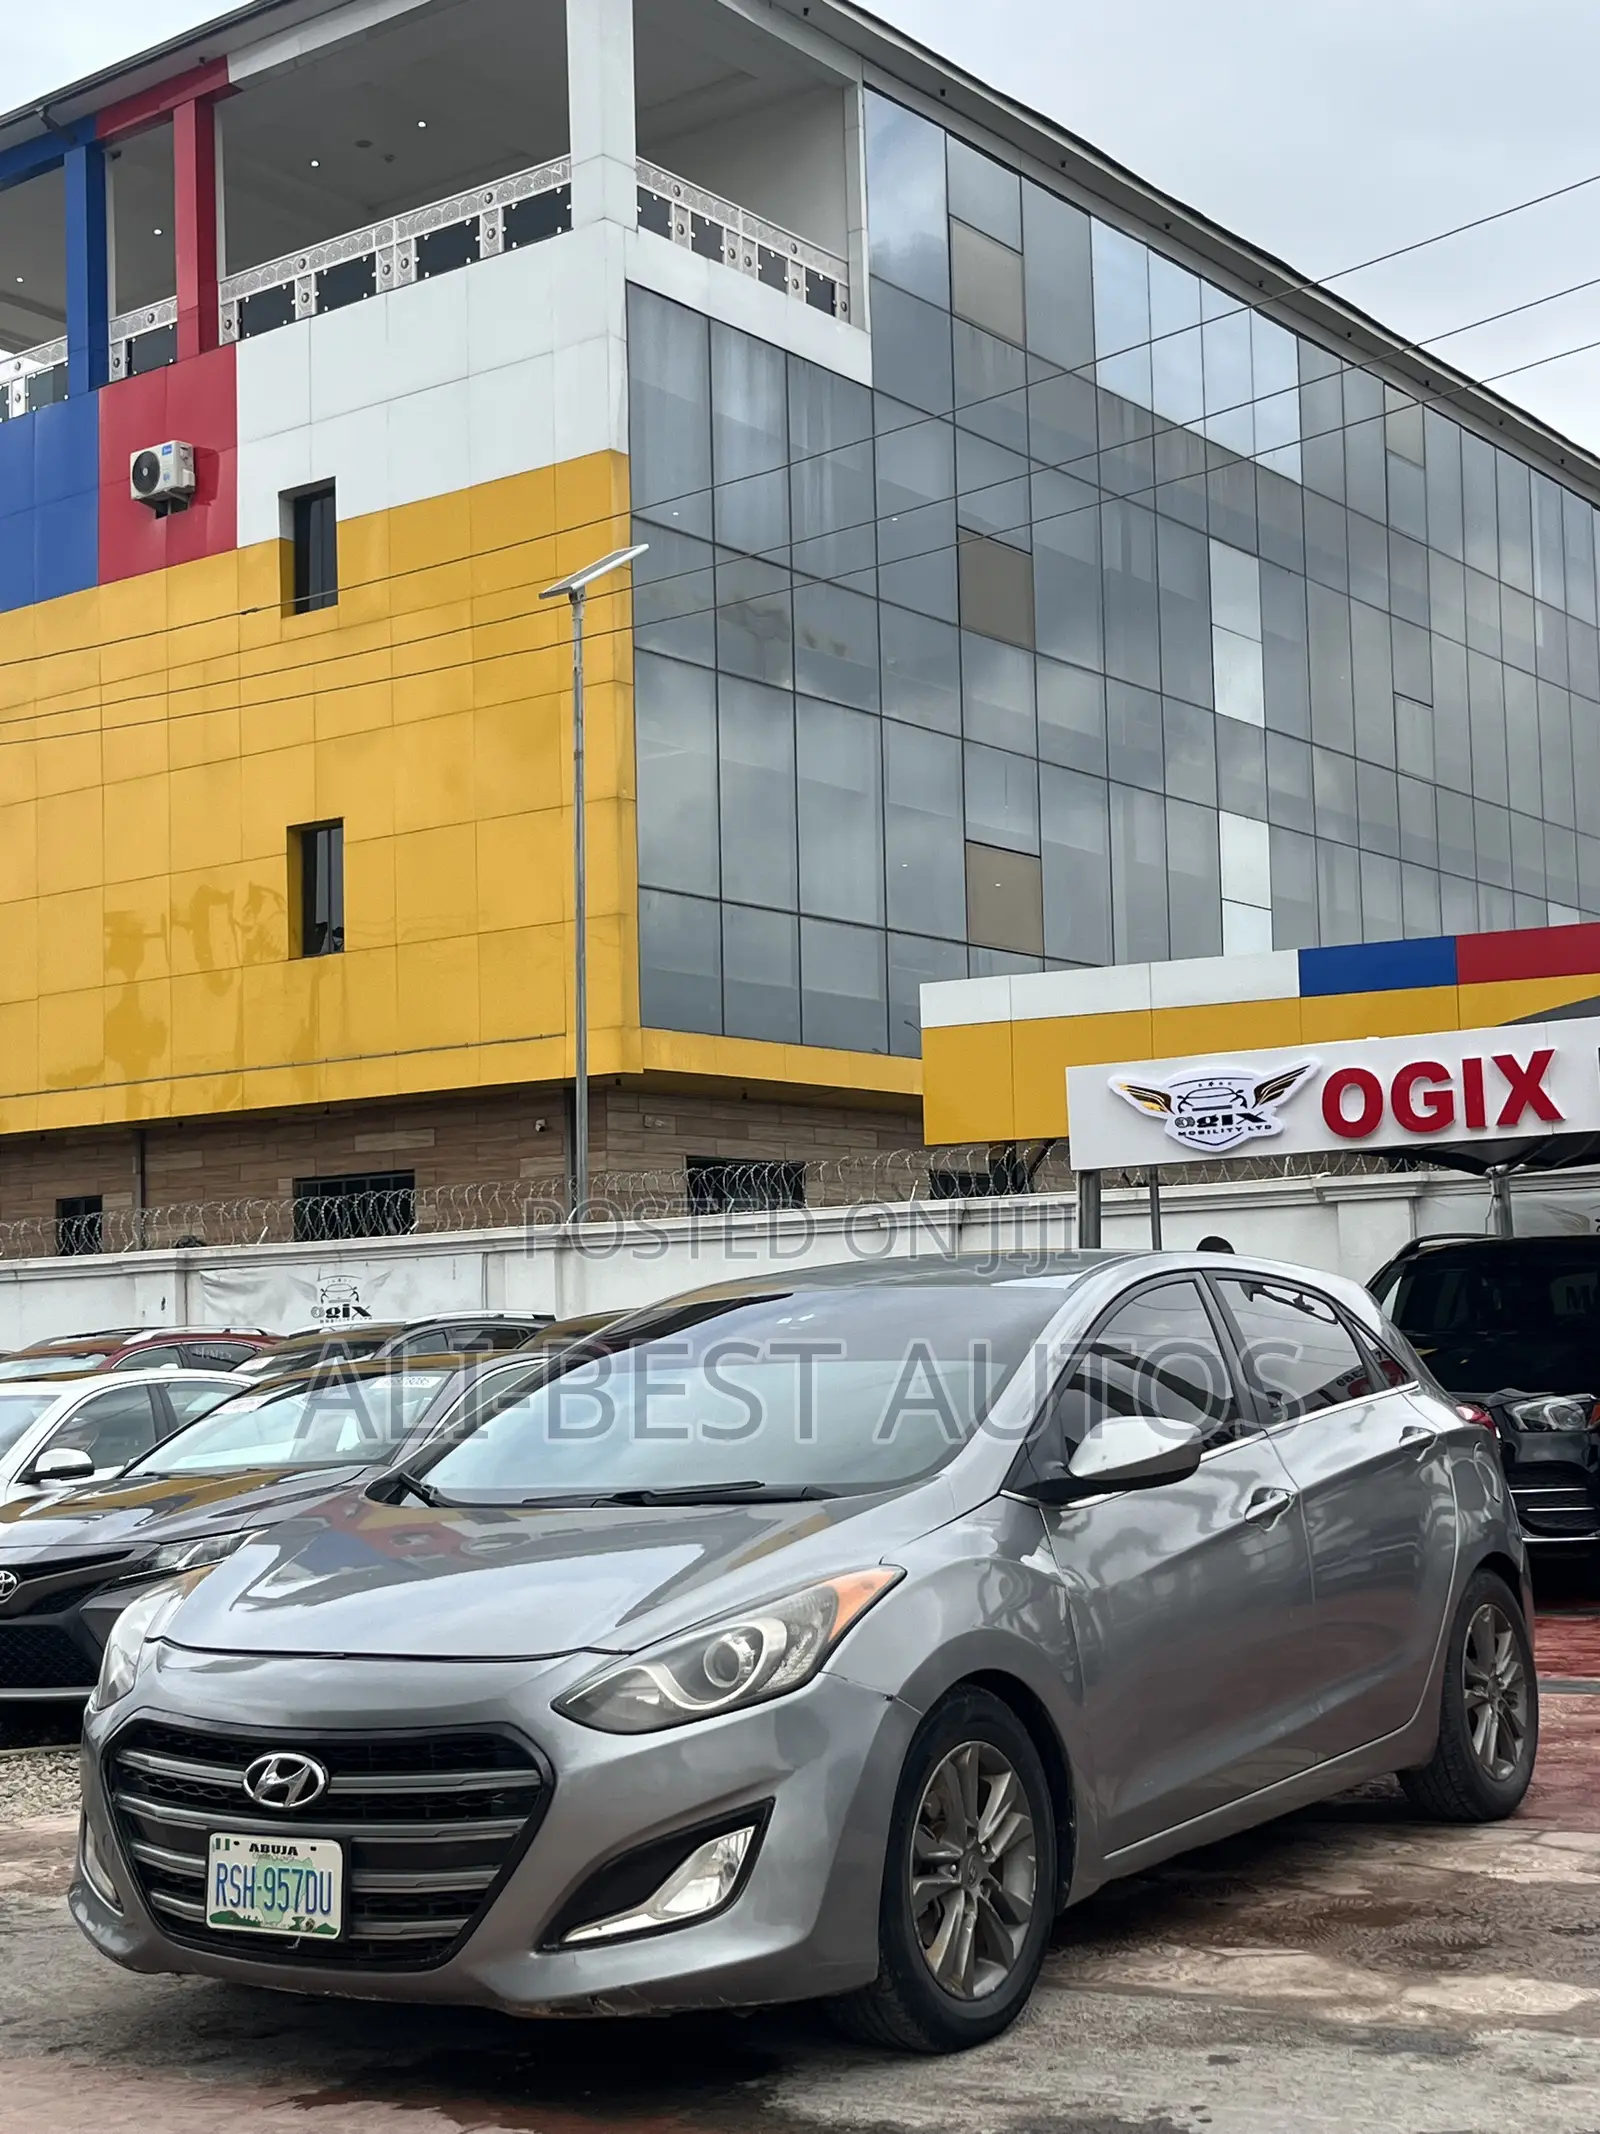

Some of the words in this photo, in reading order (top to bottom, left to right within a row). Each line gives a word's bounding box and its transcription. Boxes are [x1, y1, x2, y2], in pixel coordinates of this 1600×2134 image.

[1321, 1049, 1565, 1138] OGIX
[1178, 1127, 1242, 1137] MOBILITY
[1247, 1123, 1272, 1132] LTD
[249, 1843, 298, 1856] ABUJA
[216, 1863, 332, 1915] RSH-957DU
